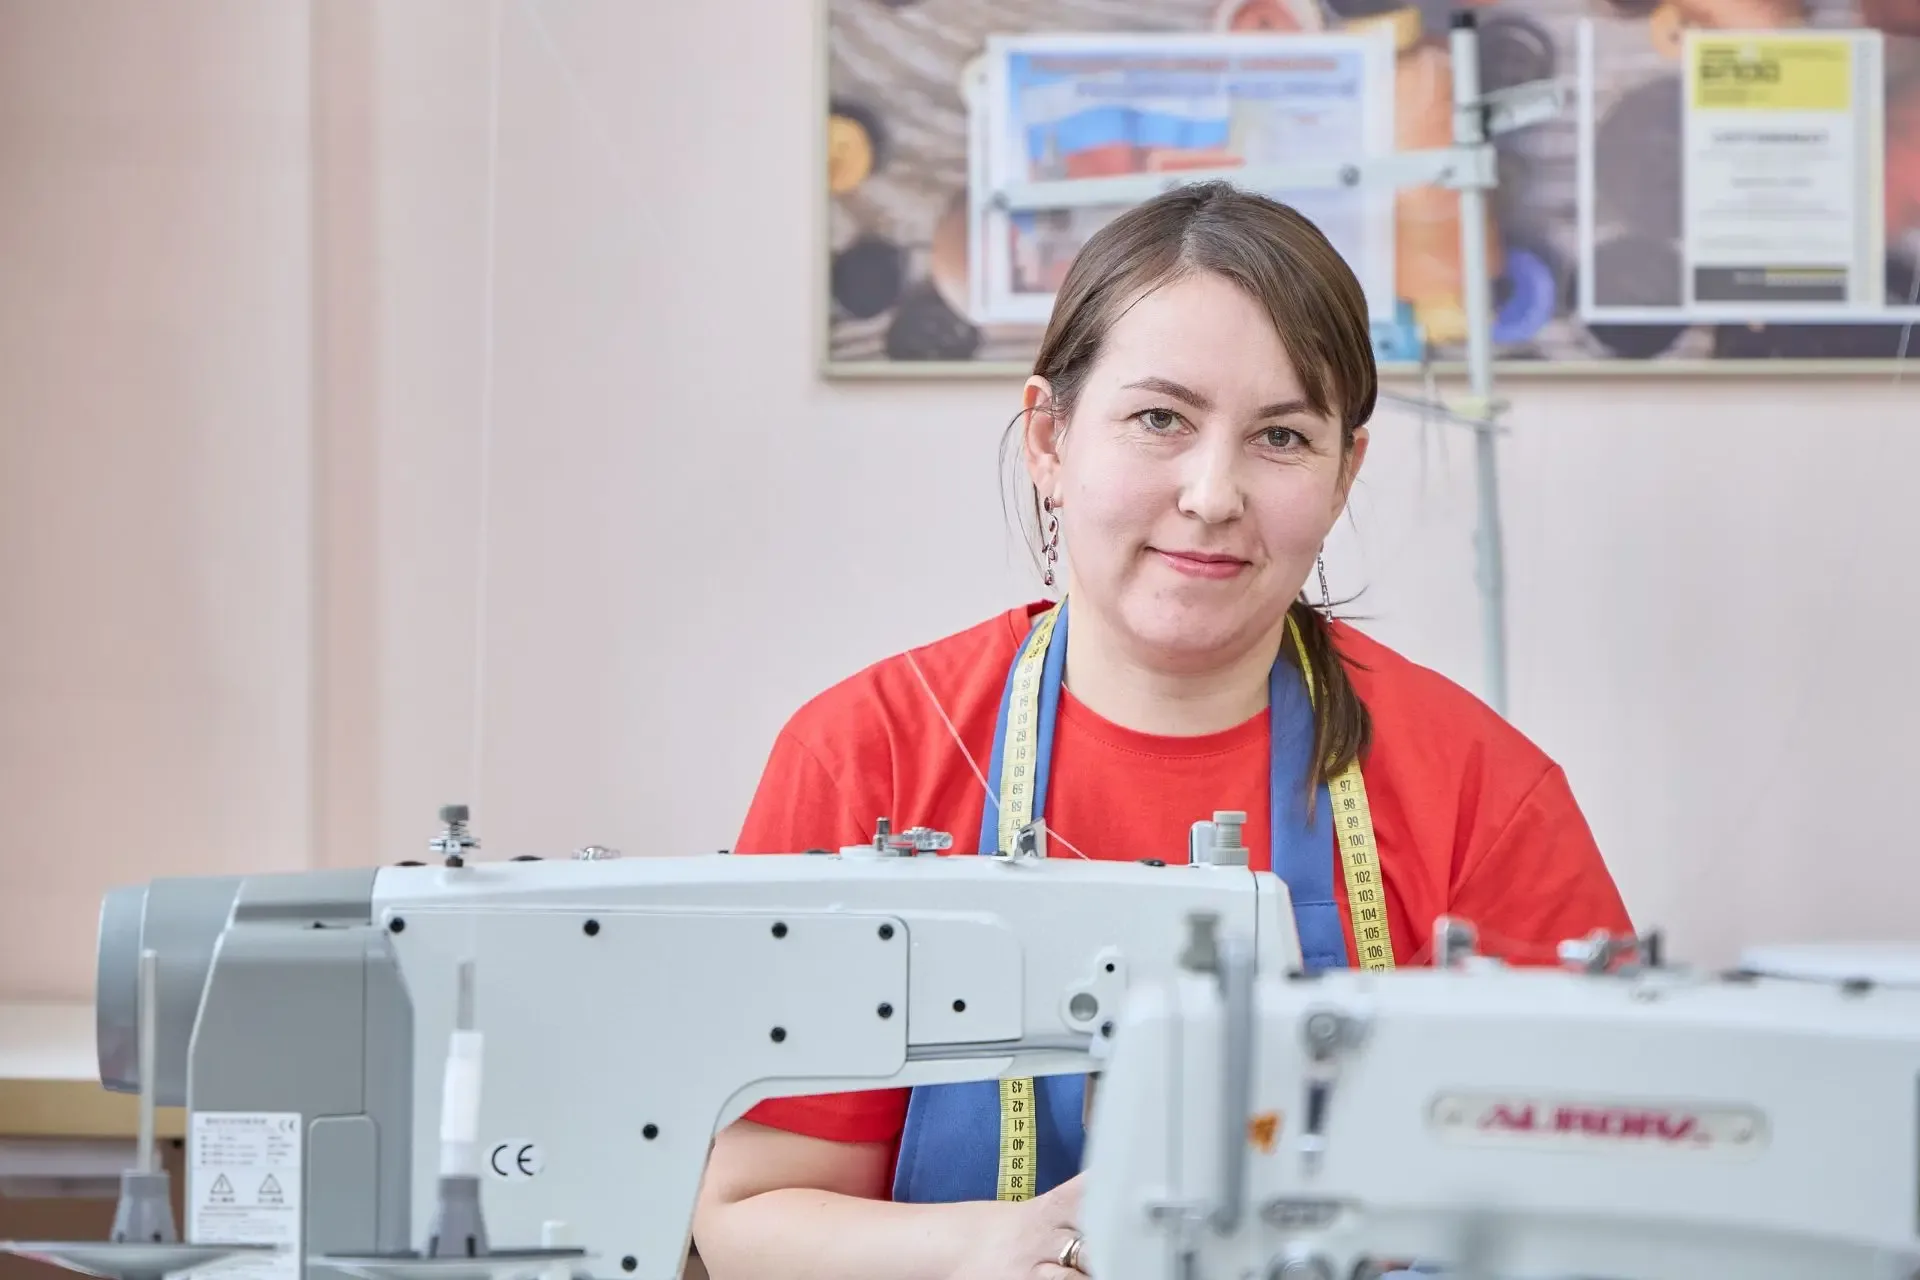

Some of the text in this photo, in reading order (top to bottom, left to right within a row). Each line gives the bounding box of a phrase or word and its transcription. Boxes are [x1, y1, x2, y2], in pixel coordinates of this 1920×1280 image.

[1016, 730, 1027, 742] 62
[1016, 748, 1026, 760] 61
[1014, 766, 1025, 777] 60
[1012, 783, 1023, 794] 59
[1339, 779, 1351, 792] 97
[1011, 801, 1022, 812] 58
[1343, 798, 1356, 810] 98
[1346, 816, 1359, 828] 99
[1348, 833, 1365, 847] 100
[1351, 852, 1367, 865] 101
[1354, 870, 1371, 883] 102
[1357, 889, 1374, 902] 103
[1361, 907, 1377, 921] 104
[1363, 926, 1380, 940] 105
[1366, 944, 1383, 959] 106
[1012, 1081, 1023, 1094] 43
[1012, 1100, 1024, 1112] 42
[1014, 1119, 1024, 1132] 41
[1012, 1138, 1024, 1151] 40
[491, 1143, 534, 1177] CE
[1012, 1158, 1024, 1170] 39
[1011, 1176, 1023, 1188] 38
